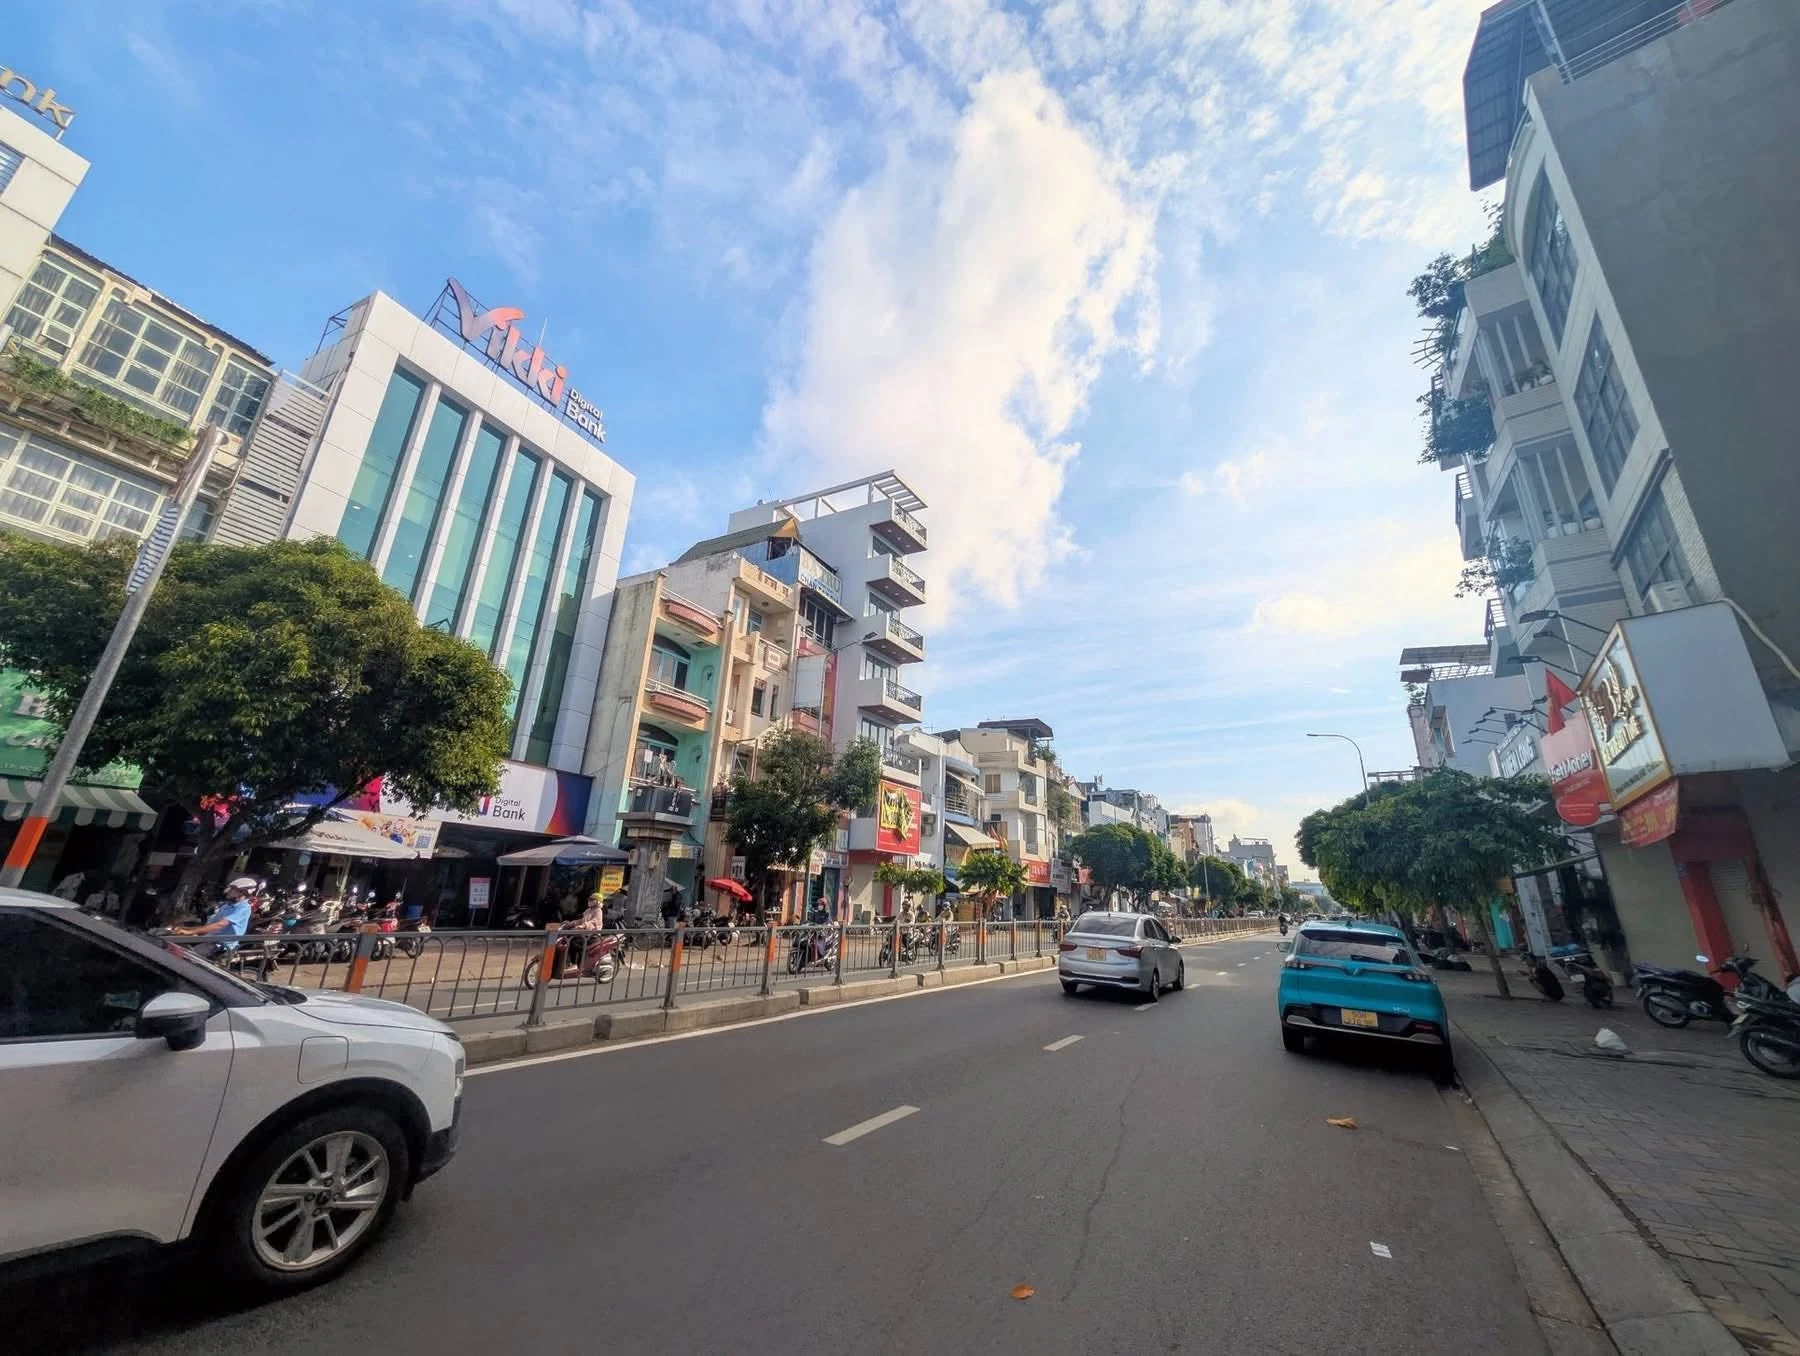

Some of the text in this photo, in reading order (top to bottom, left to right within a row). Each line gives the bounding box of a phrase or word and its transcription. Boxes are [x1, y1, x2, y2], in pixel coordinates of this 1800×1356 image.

[448, 276, 569, 408] Vikki
[570, 388, 604, 418] Digital
[567, 403, 607, 443] Bank
[493, 805, 526, 820] Bank
[495, 796, 521, 807] Digital
